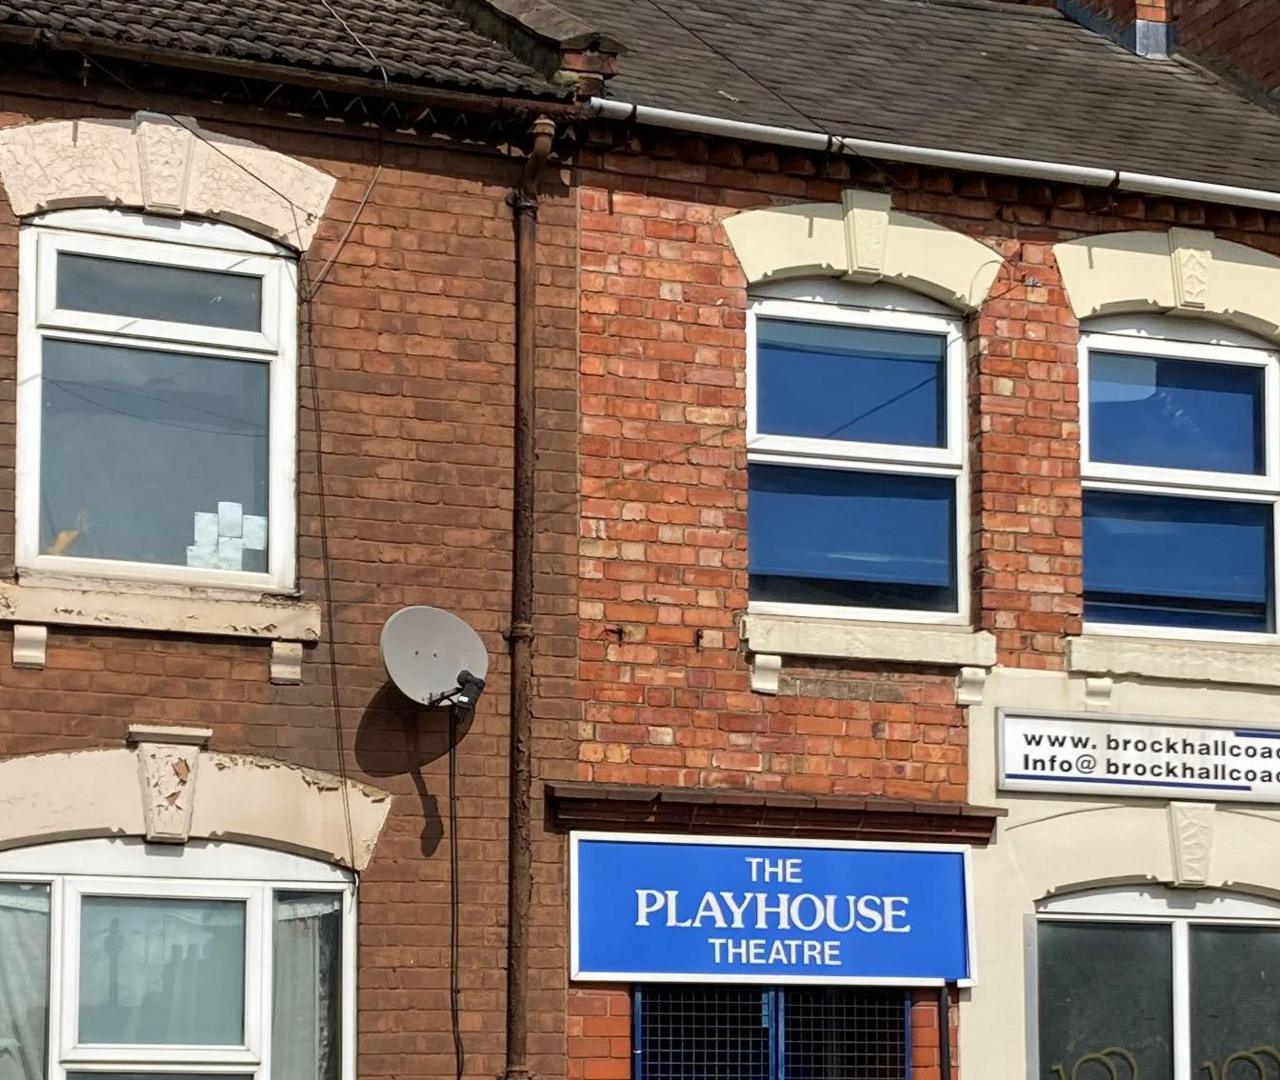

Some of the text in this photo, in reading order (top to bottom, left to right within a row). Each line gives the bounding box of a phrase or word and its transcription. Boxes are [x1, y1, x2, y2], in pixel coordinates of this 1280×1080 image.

[1022, 733, 1097, 749] www.
[1023, 753, 1098, 774] Info@
[745, 857, 803, 883] THE
[635, 889, 911, 933] PLAYHOUSE
[708, 938, 842, 965] THEATRE
